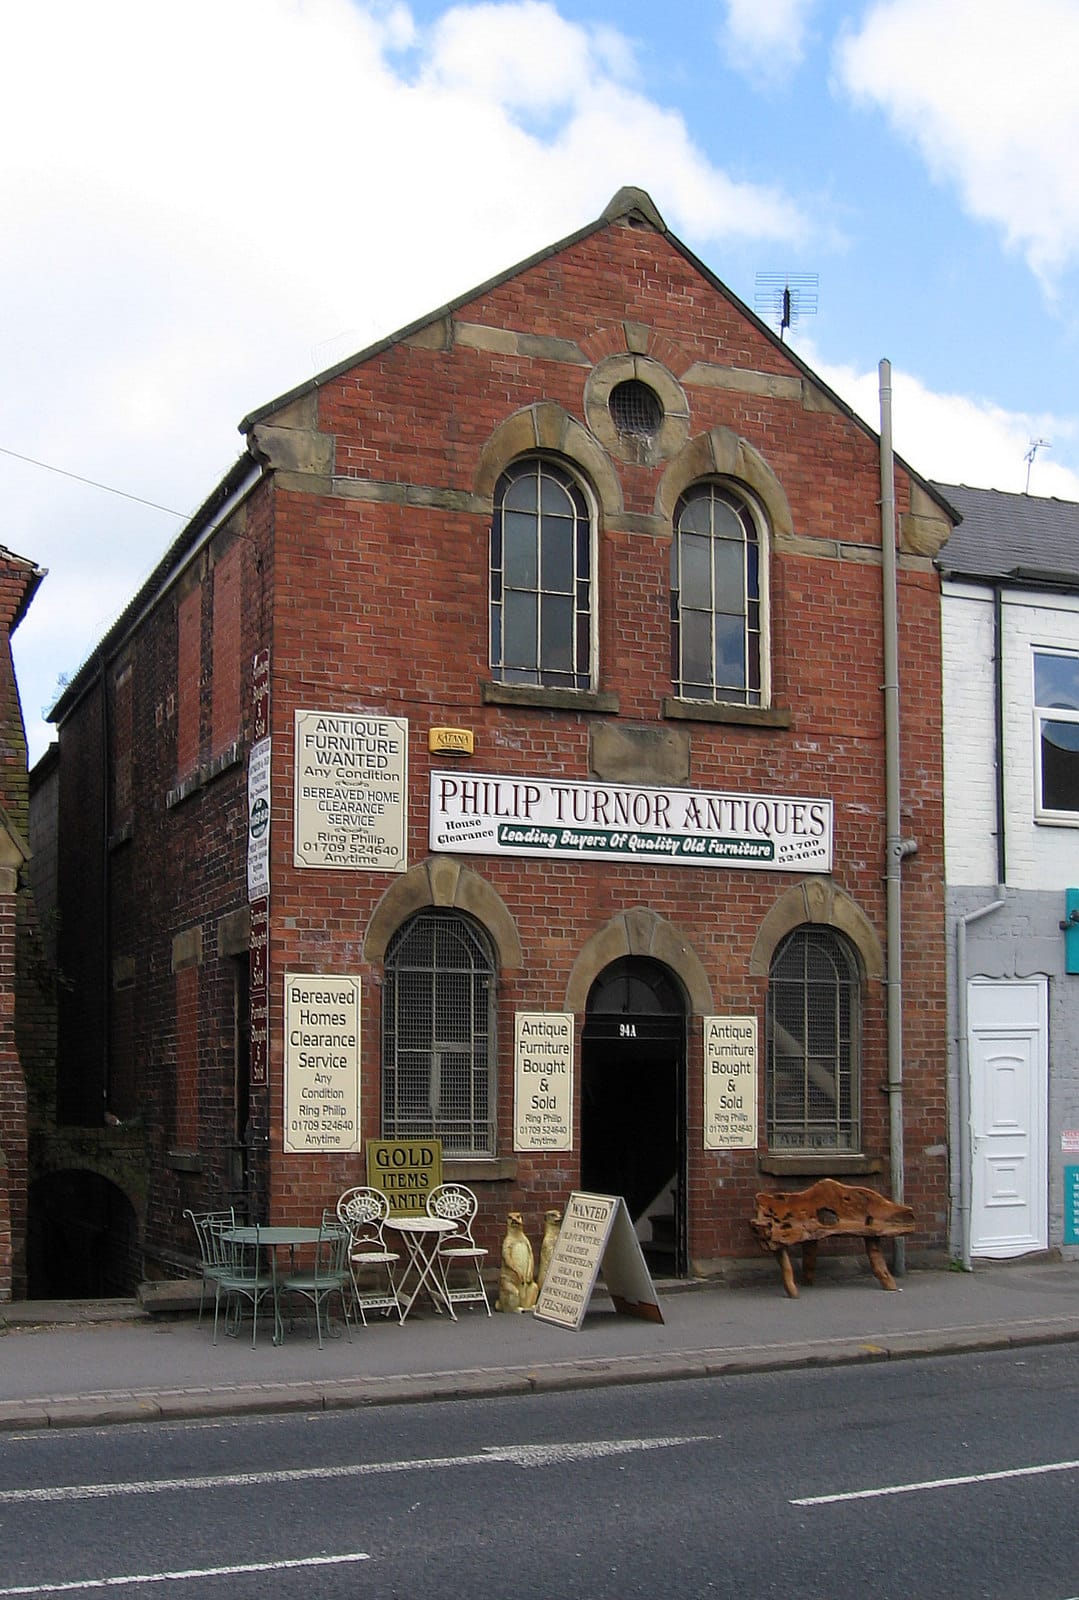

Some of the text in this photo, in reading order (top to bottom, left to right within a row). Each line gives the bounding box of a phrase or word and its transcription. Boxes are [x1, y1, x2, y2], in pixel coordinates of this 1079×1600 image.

[316, 719, 389, 738] ANTIQUE
[305, 735, 399, 754] FURNITURE
[316, 752, 389, 769] WANTED
[304, 766, 400, 782] Any Condition
[302, 787, 400, 803] BEREAVED HOME
[318, 801, 385, 815] CLEARANCE
[438, 779, 825, 838] PHILIP TURNOR ANTIQUES
[328, 814, 375, 827] SERVICE
[445, 818, 482, 831] House
[318, 832, 386, 846] Ring Philip
[438, 830, 494, 845] Clearance
[501, 827, 771, 858] Leading Buyers Of Quality Old Furniture
[303, 842, 399, 856] 01709 524640
[780, 839, 820, 853] 01709
[324, 853, 379, 865] Anytime
[778, 849, 826, 864] 524640
[291, 988, 355, 1005] Bereaved
[300, 1010, 346, 1026] Homes
[522, 1021, 568, 1038] Antique
[619, 1023, 637, 1038] 94A
[710, 1024, 753, 1041] Antique
[290, 1031, 356, 1048] Clearance
[519, 1041, 570, 1055] Furniture
[708, 1043, 754, 1057] Furniture
[298, 1052, 348, 1068] Service
[523, 1059, 566, 1076] Bought
[712, 1061, 752, 1077] Bought
[314, 1073, 333, 1086] Any
[540, 1078, 549, 1092] &
[727, 1079, 736, 1093] &
[301, 1088, 344, 1100] Condition
[531, 1095, 557, 1110] Sold
[719, 1096, 743, 1109] Sold
[299, 1105, 347, 1117] Ring Philip
[714, 1113, 730, 1123] Ring
[292, 1120, 353, 1131] 01709 524640
[525, 1114, 562, 1124] Ring Philip
[519, 1126, 568, 1136] 01709 524640
[709, 1125, 729, 1134] 01709
[304, 1134, 341, 1146] Anytime
[529, 1136, 558, 1146] Anytime
[376, 1148, 434, 1167] GOLD
[382, 1173, 429, 1188] ITEMS
[572, 1202, 608, 1220] WANTED
